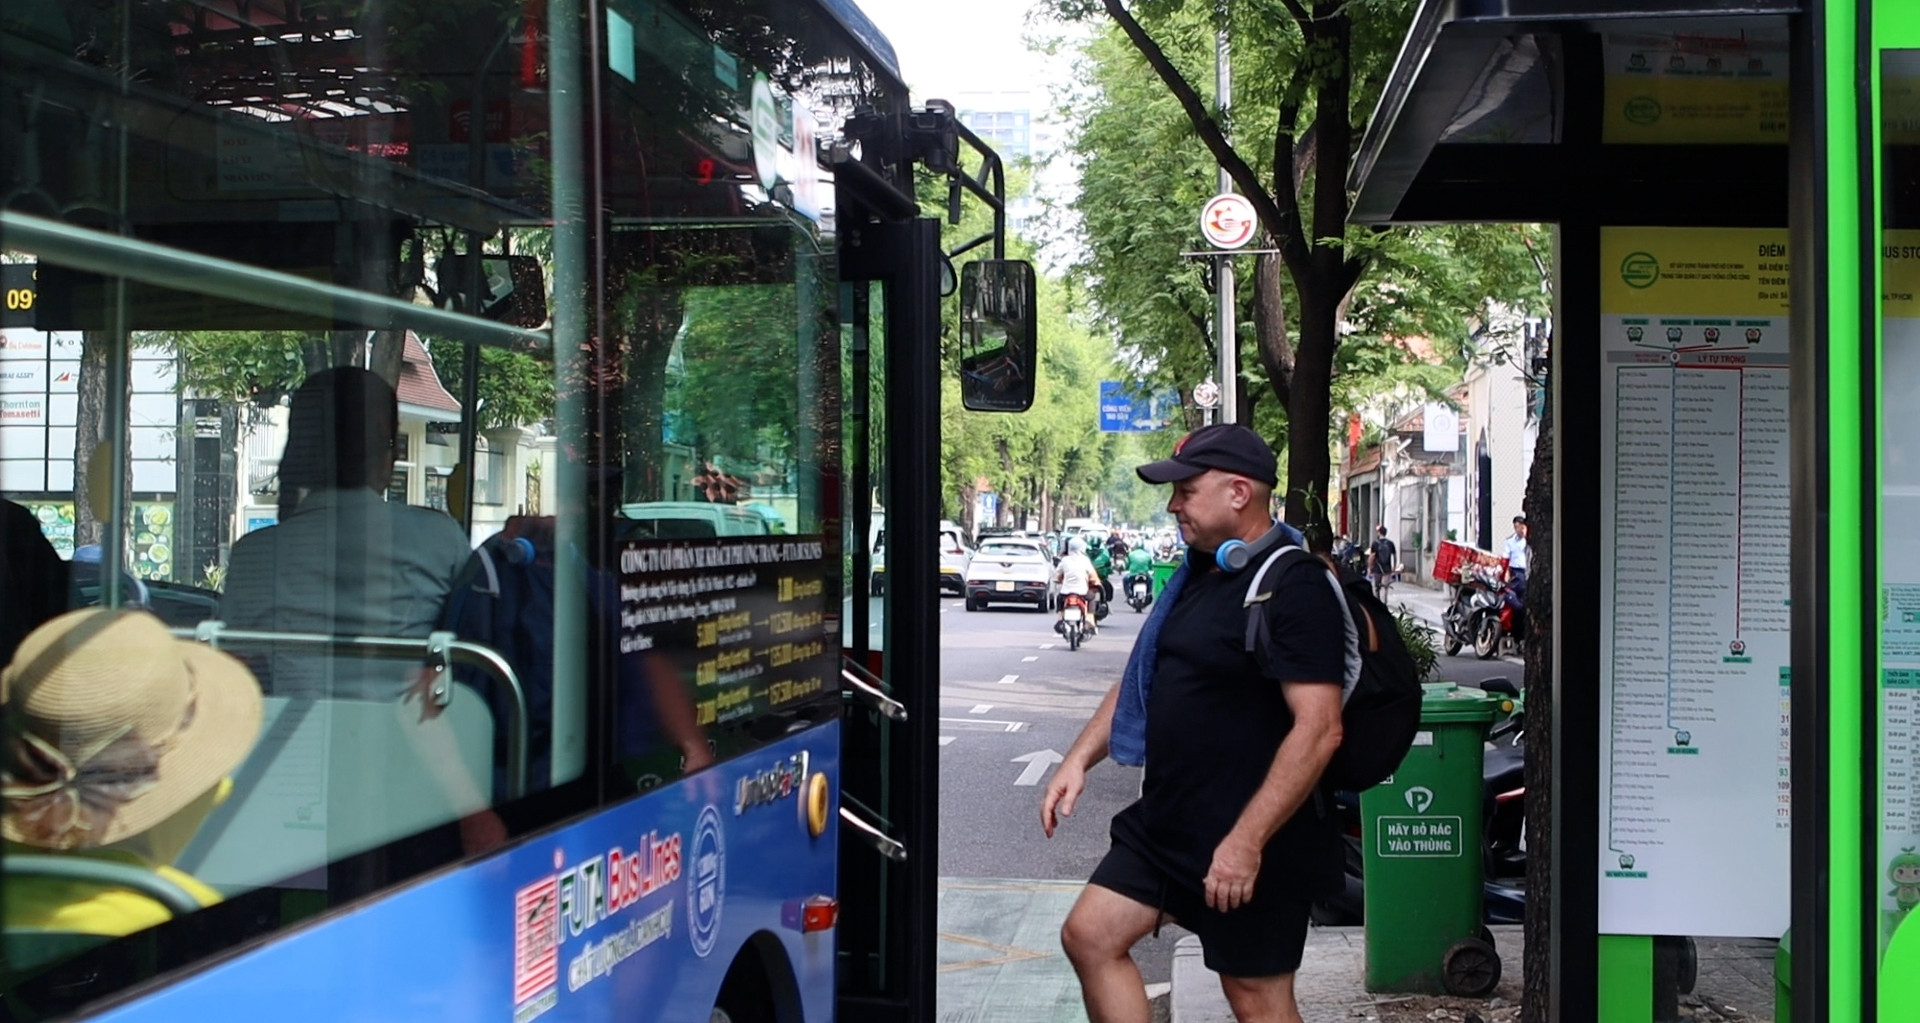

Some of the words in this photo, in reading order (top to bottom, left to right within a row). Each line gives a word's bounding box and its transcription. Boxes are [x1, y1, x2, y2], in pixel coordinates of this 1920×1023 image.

[697, 157, 716, 186] 9
[1759, 243, 1786, 257] ĐIỂM
[1769, 262, 1784, 272] ĐIỂM
[1758, 276, 1770, 286] TÊN
[1771, 276, 1786, 286] ĐIỂM
[1697, 353, 1709, 364] LÝ
[1709, 354, 1719, 365] TỰ
[1720, 354, 1746, 365] TRỌNG
[621, 542, 648, 574] CÔNG
[1780, 714, 1790, 724] 31
[1780, 727, 1789, 737] 36
[1778, 768, 1788, 777] 93
[1777, 782, 1790, 790] 109
[1777, 795, 1790, 803] 152
[1776, 808, 1788, 817] 171
[1388, 822, 1409, 835] HÃY
[1412, 822, 1427, 835] BỎ
[1429, 822, 1452, 835] RÁC
[1388, 837, 1411, 851] VÀO
[1413, 838, 1452, 851] THÙNG
